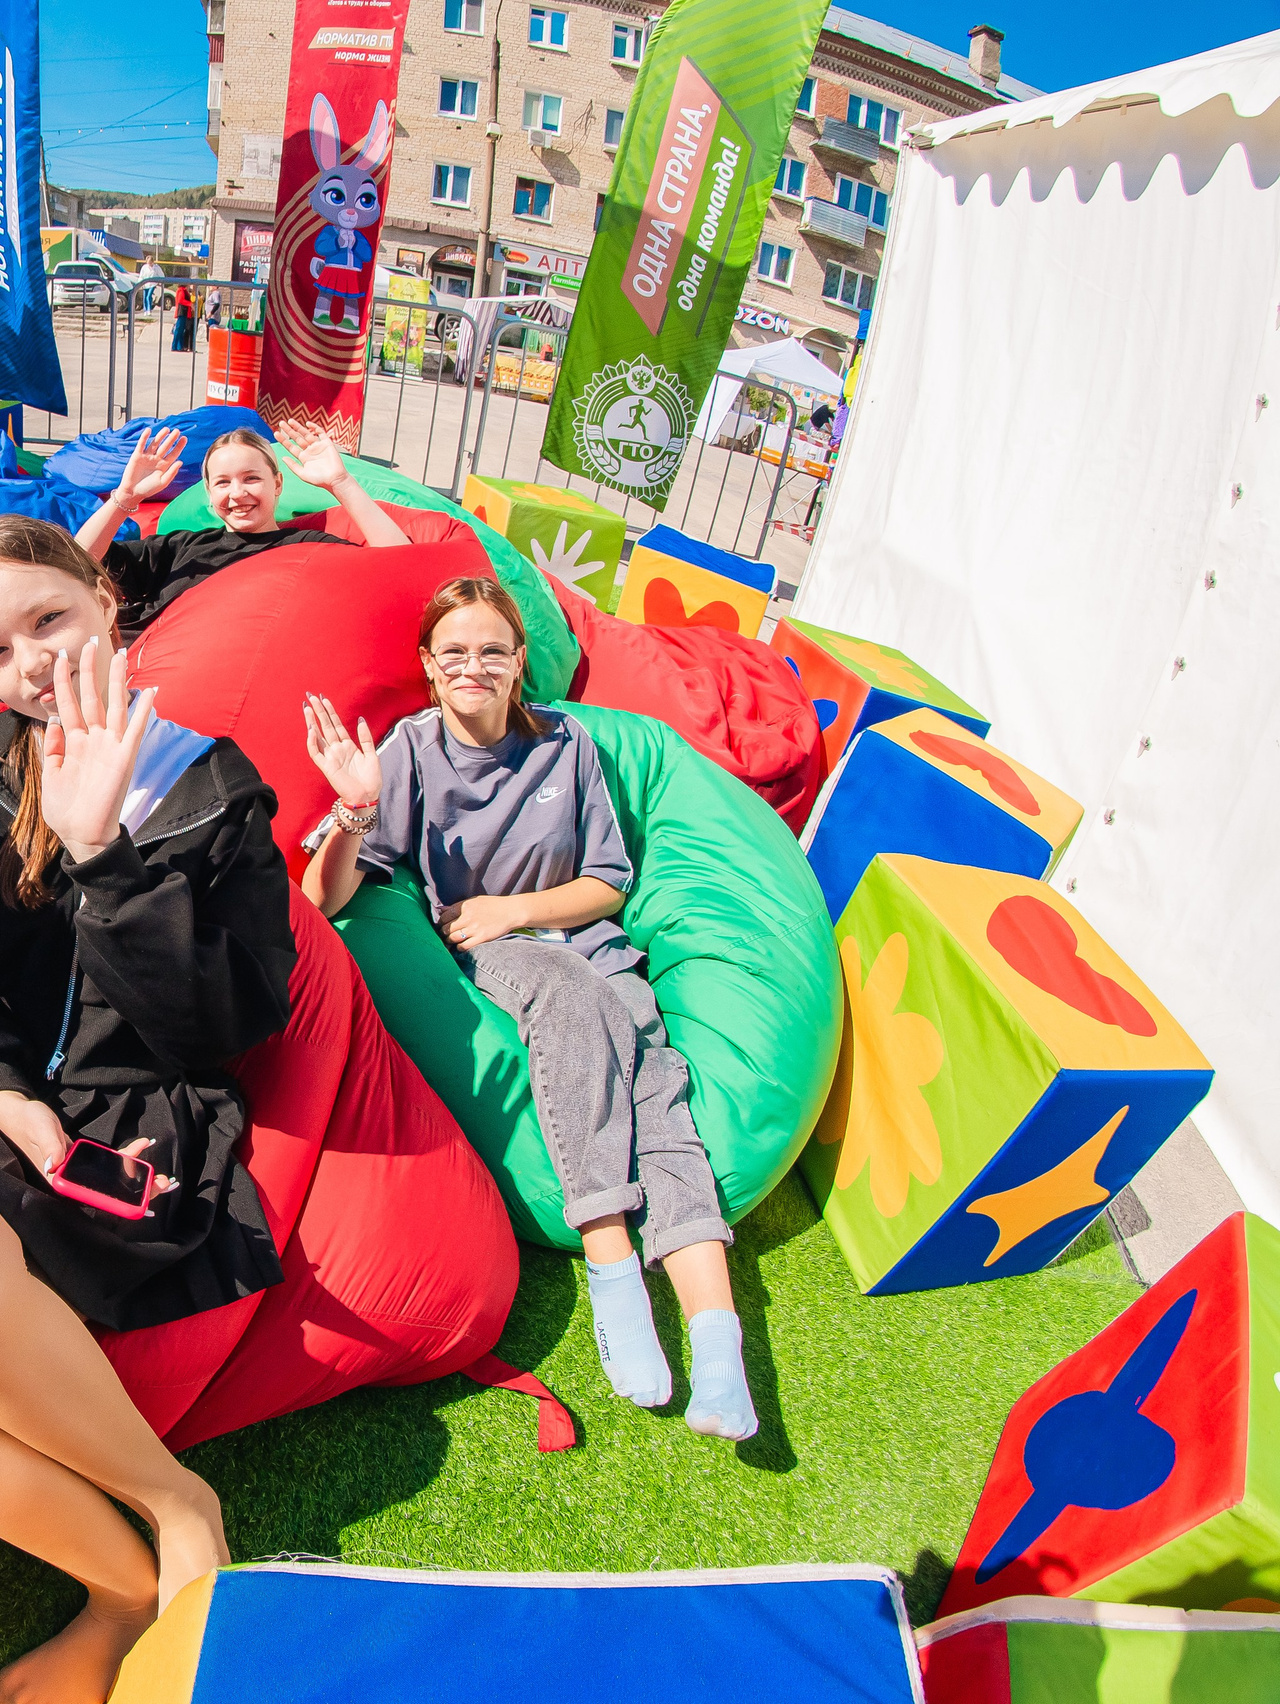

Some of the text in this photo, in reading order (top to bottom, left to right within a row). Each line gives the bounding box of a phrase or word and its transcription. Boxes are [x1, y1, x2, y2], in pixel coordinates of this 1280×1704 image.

[316, 32, 378, 47] НОРМАТИВ
[334, 51, 365, 62] норма
[632, 103, 712, 298] ОДНА СТРАНА,
[676, 136, 741, 312] одна команда!
[537, 254, 584, 276] АПТ
[618, 441, 654, 460] ГТО
[541, 786, 558, 797] NIKE
[596, 1321, 611, 1363] LACOSTE
